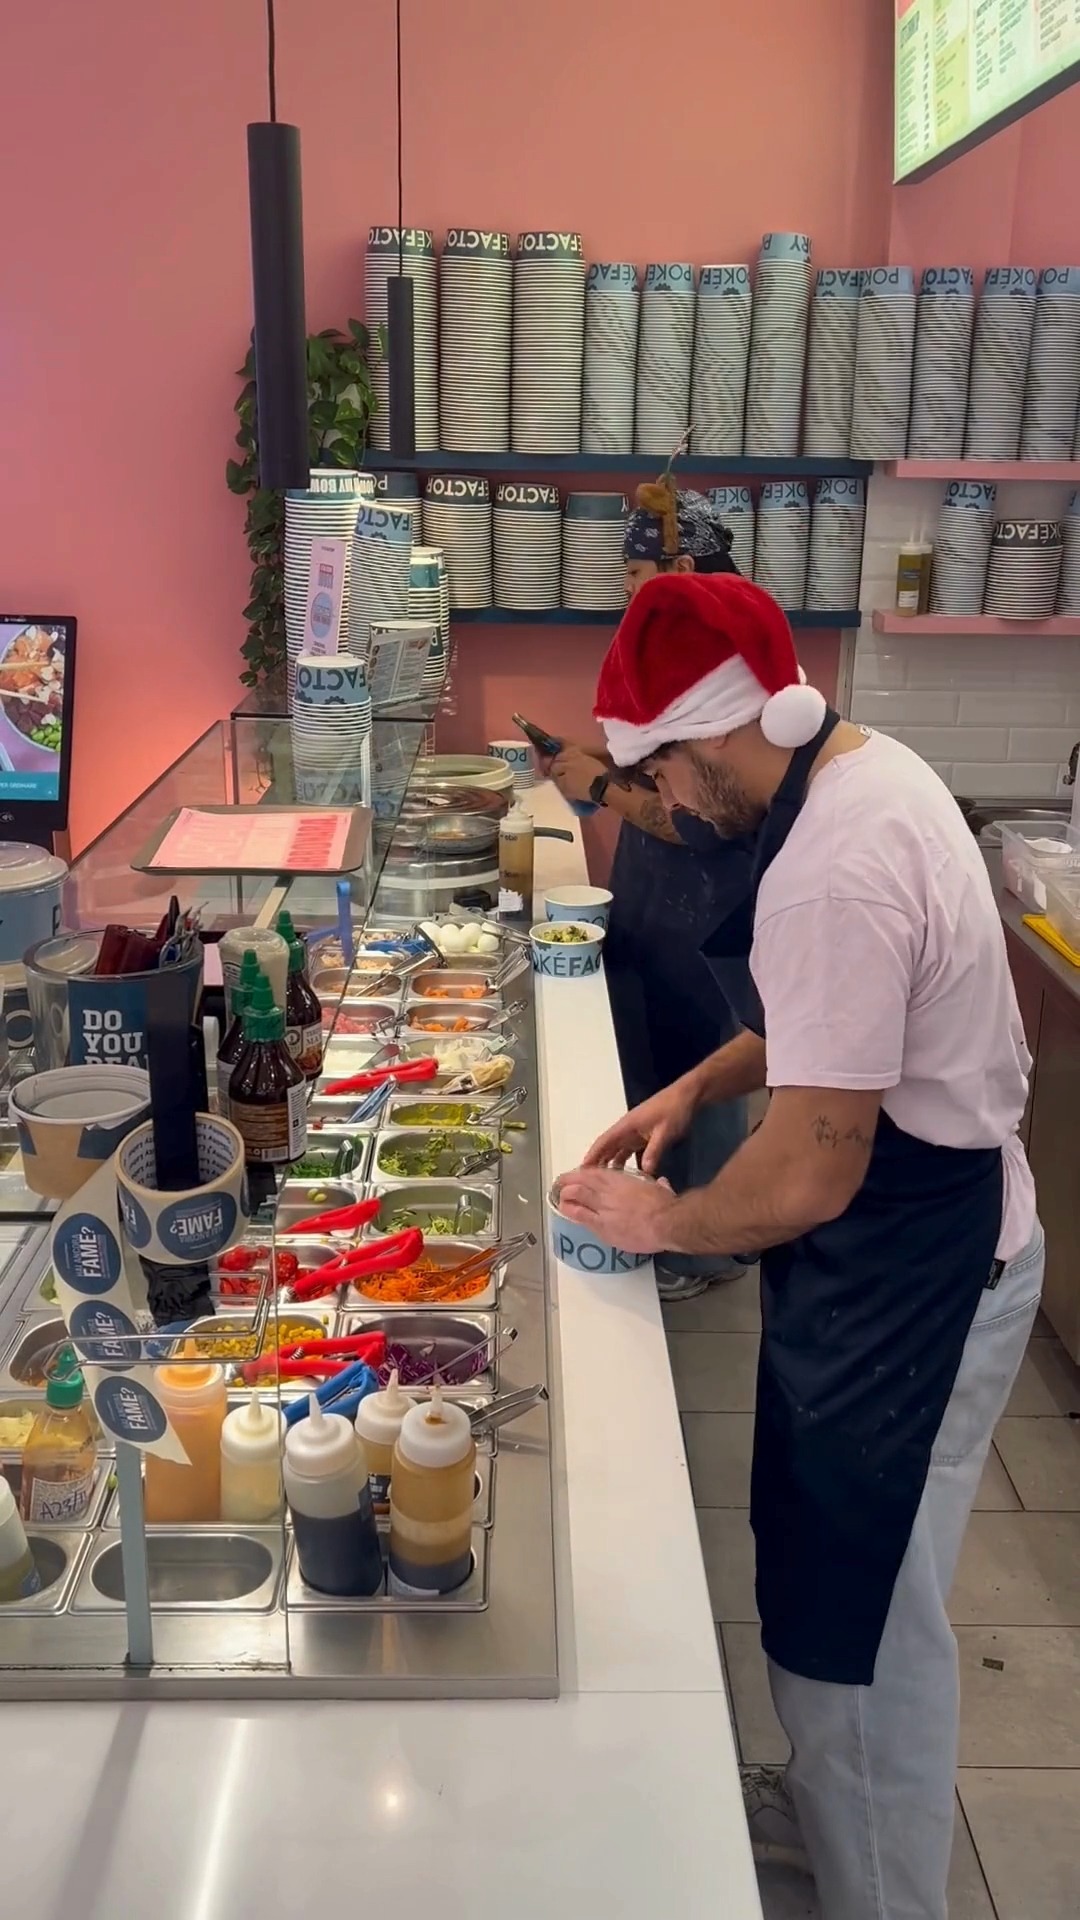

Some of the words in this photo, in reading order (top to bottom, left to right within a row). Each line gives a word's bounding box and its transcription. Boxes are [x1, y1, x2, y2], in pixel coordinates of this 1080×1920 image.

[83, 1009, 122, 1031] DO
[83, 1032, 143, 1054] YOU
[169, 1207, 223, 1236] FAME?
[80, 1226, 102, 1277] FAME?
[120, 1387, 149, 1430] FAME?
